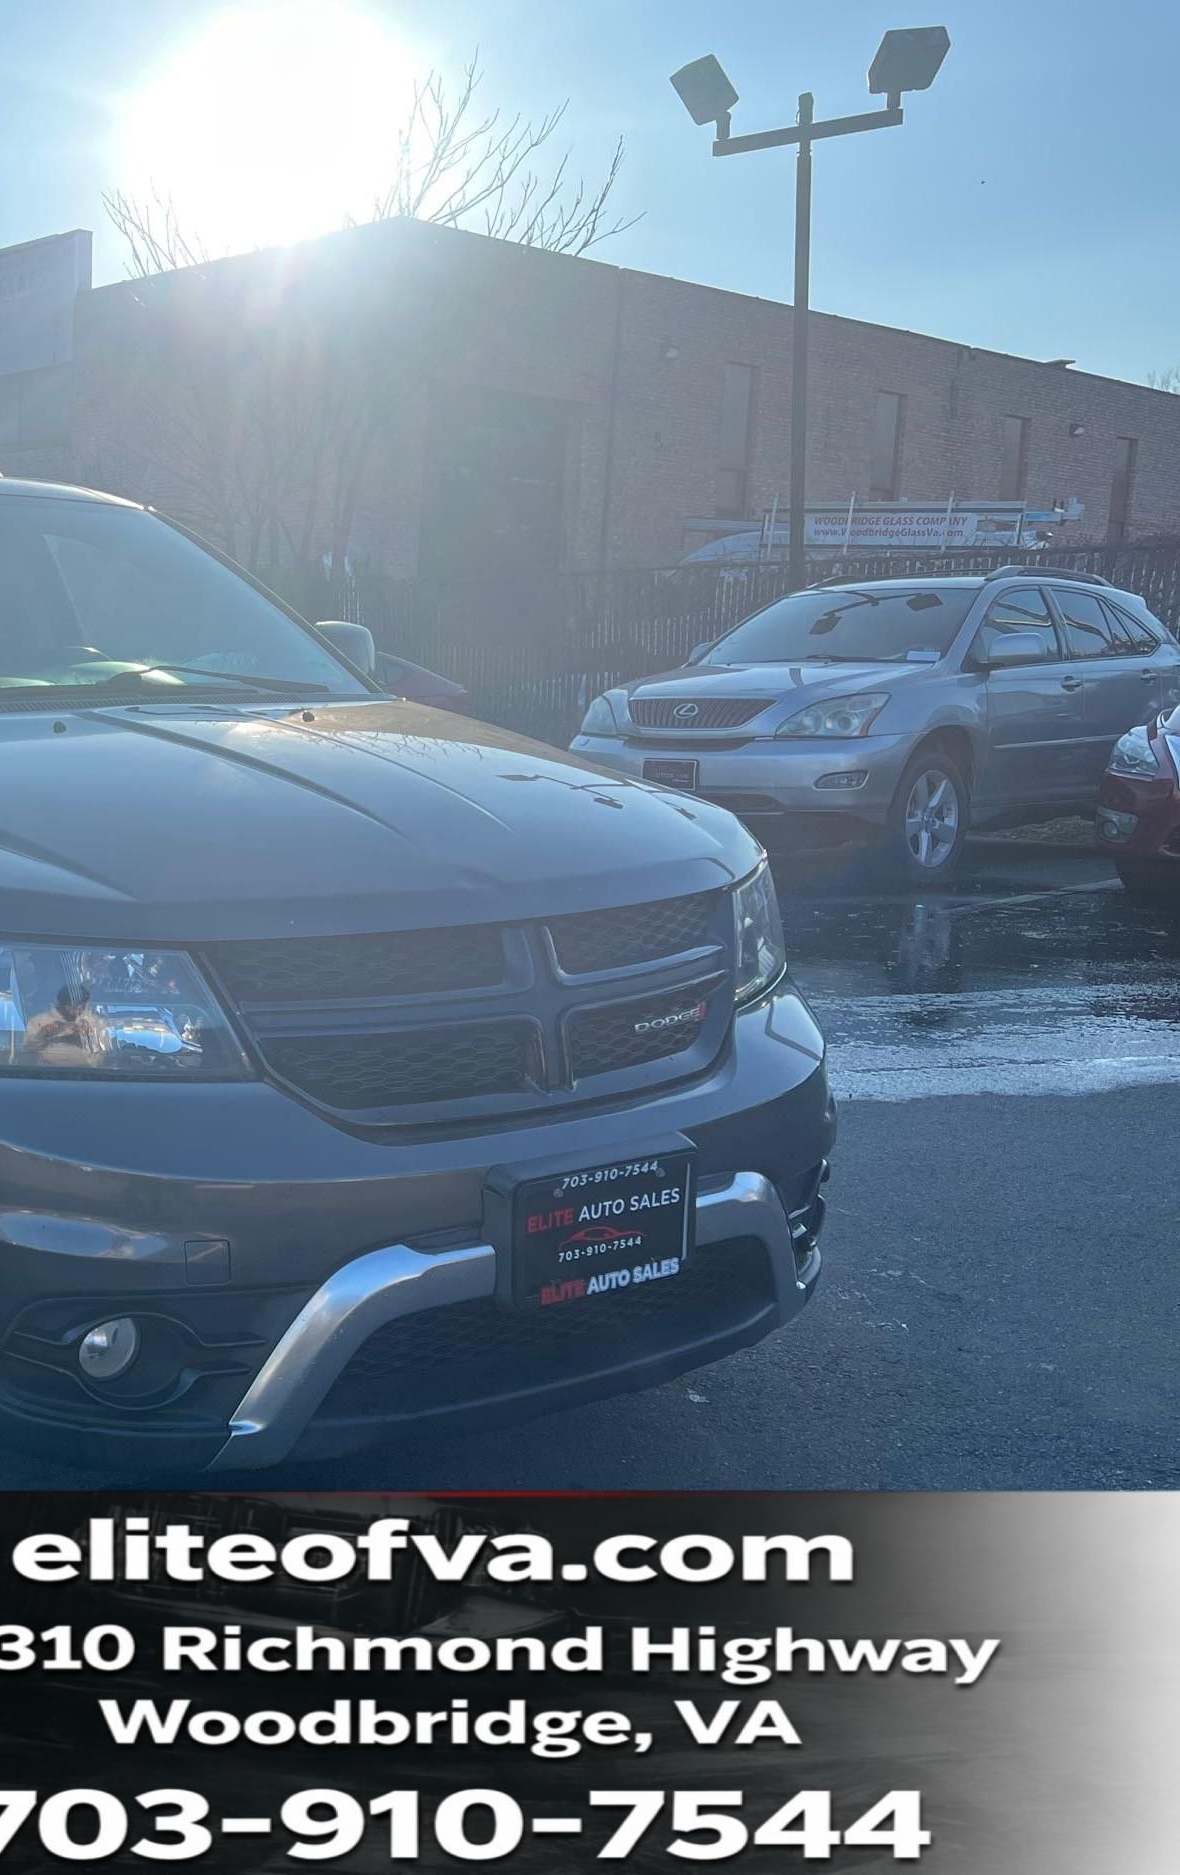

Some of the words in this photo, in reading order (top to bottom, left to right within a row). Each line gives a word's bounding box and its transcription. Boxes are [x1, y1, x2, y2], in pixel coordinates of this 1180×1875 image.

[814, 516, 881, 526] WOODRIDGE
[882, 516, 914, 526] GLASS
[814, 528, 963, 539] www.oodbridgeGlassVa.om
[635, 1008, 700, 1032] DODGE
[562, 1161, 659, 1190] 703-910-7544
[527, 1208, 575, 1233] ELITE
[578, 1199, 625, 1223] AUTO
[630, 1188, 680, 1211] SALES
[558, 1236, 642, 1263] 703-910-7544
[541, 1279, 586, 1306] ELITE
[586, 1269, 631, 1296] AUTO
[633, 1257, 680, 1285] SALES
